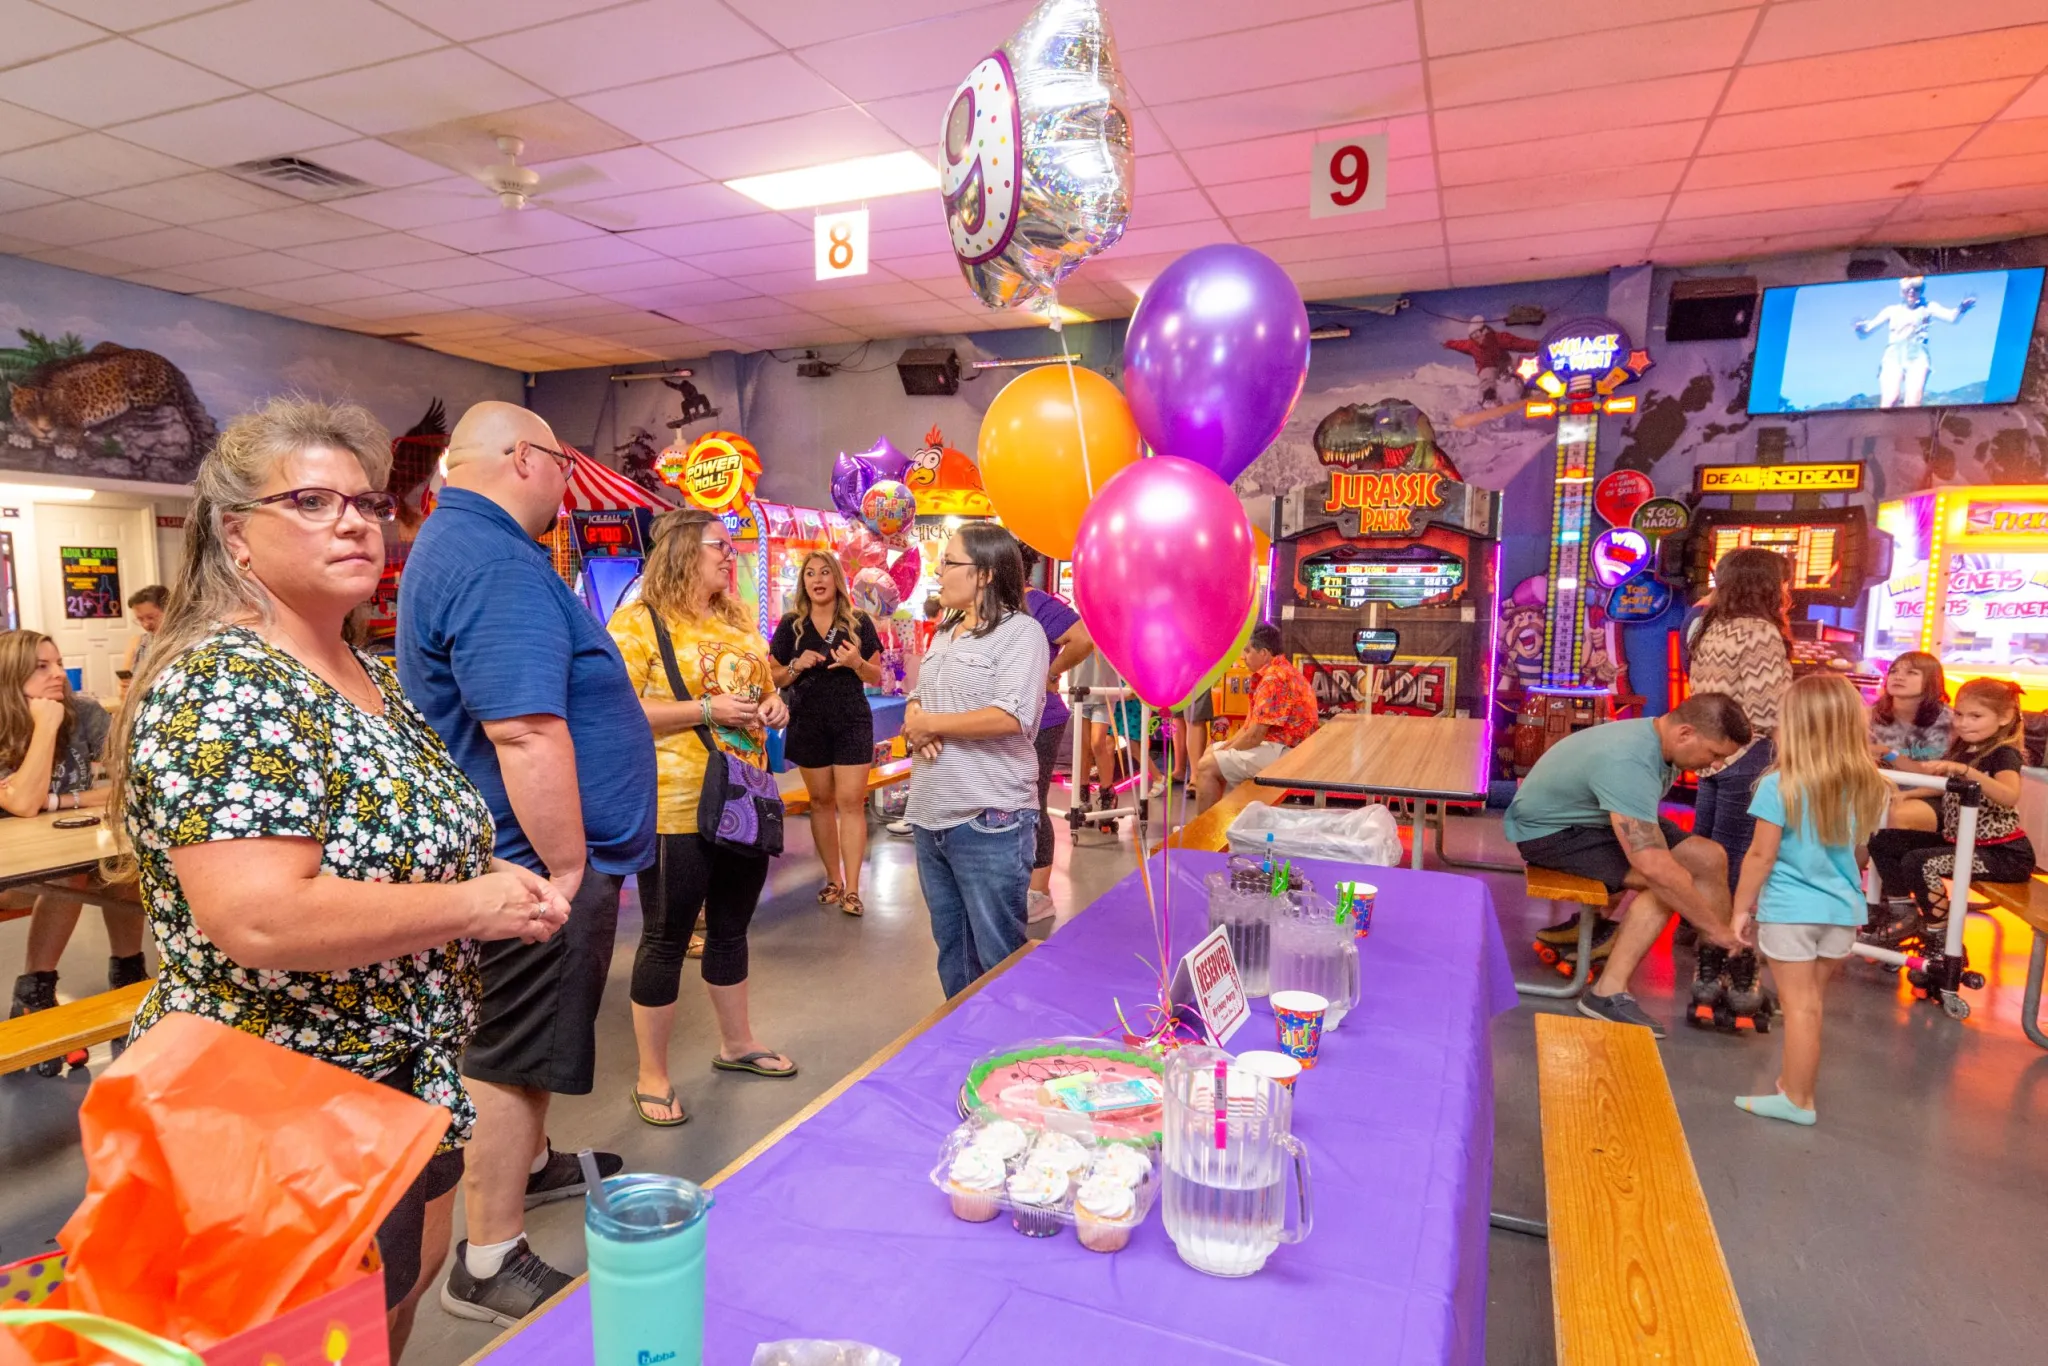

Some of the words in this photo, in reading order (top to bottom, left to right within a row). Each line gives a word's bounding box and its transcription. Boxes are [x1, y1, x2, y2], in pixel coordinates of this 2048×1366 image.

[1329, 145, 1370, 206] 9
[828, 223, 854, 270] 8
[1548, 334, 1620, 359] WHACK
[686, 455, 742, 484] POWER
[1706, 473, 1755, 485] DEAL
[1771, 471, 1799, 485] NO
[1801, 469, 1855, 484] DEAL
[695, 472, 729, 493] ROLL
[1326, 472, 1442, 511] JURASSIC
[1360, 508, 1412, 534] PARK
[1646, 507, 1677, 518] TOO
[588, 527, 622, 543] 2700
[63, 548, 88, 558] ADULT
[90, 548, 117, 559] SKATE
[67, 596, 93, 613] 21+
[1985, 601, 2048, 617] TICKET
[1311, 669, 1439, 711] ARCADE
[1196, 945, 1231, 994] RESERVED
[638, 1350, 676, 1366] bubba
